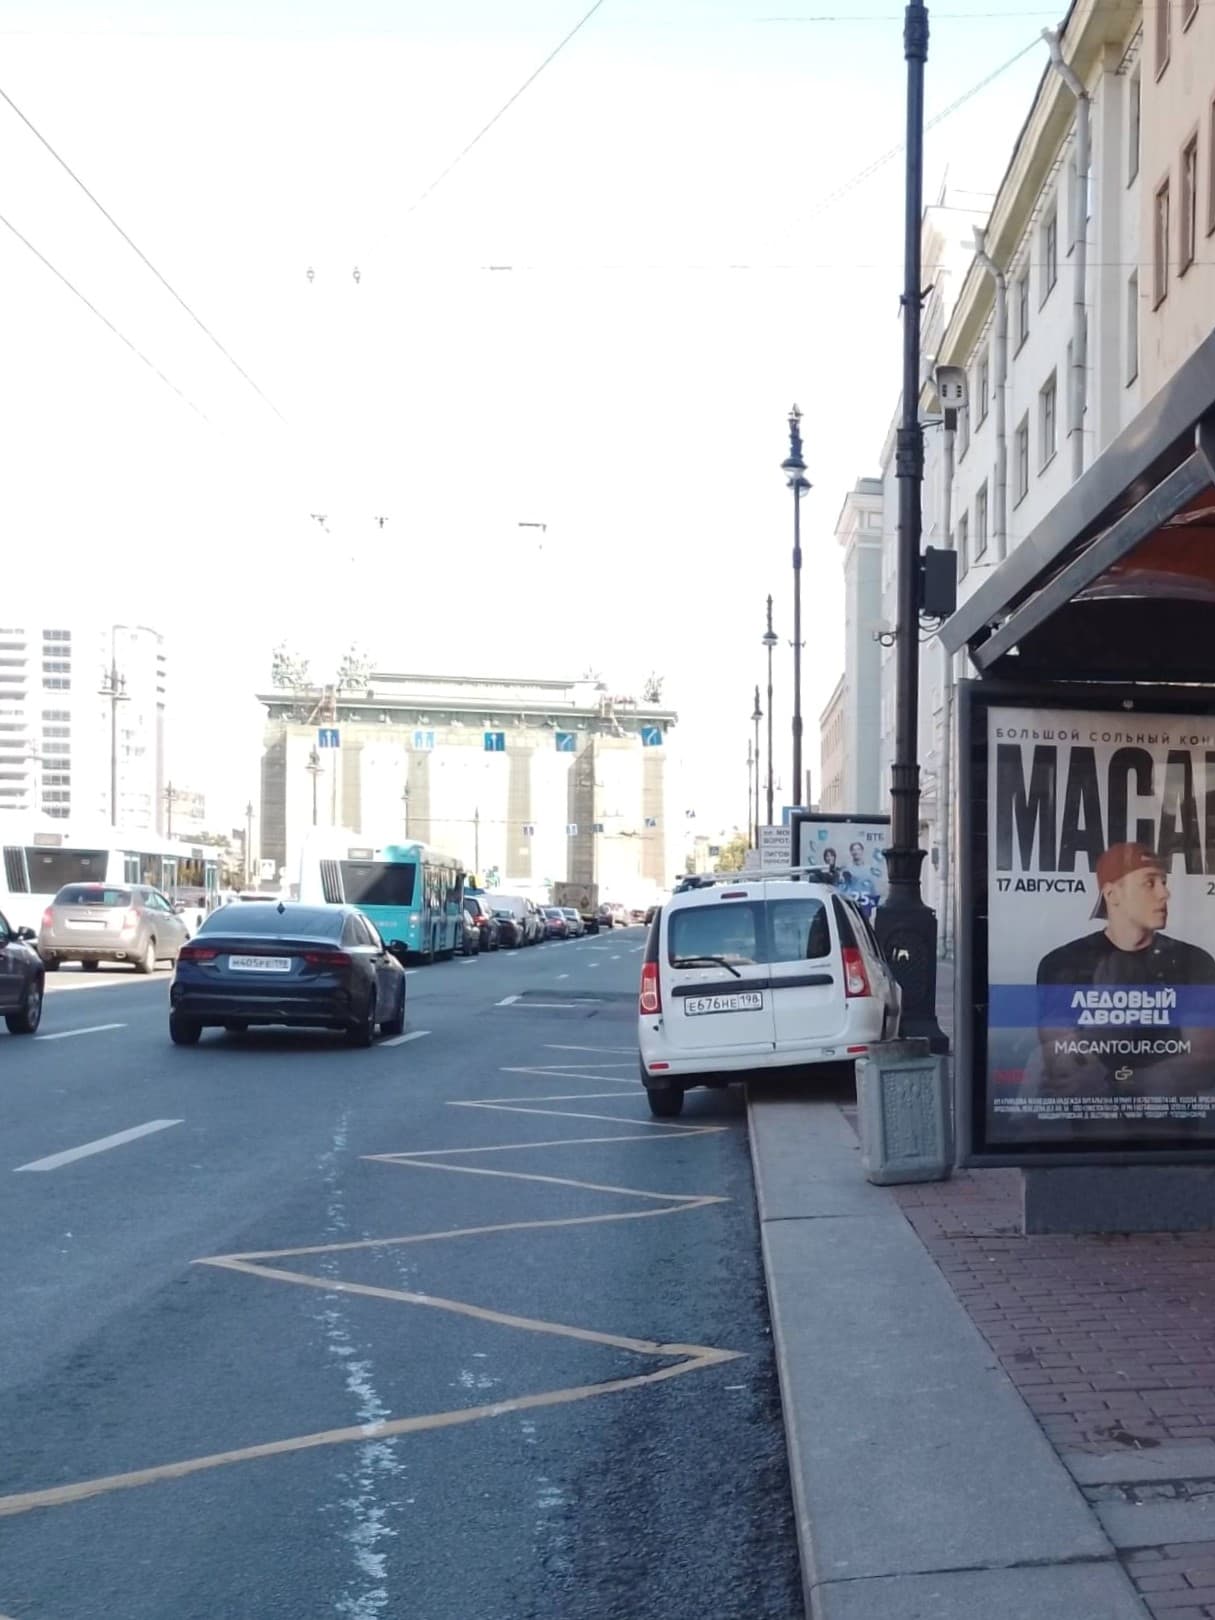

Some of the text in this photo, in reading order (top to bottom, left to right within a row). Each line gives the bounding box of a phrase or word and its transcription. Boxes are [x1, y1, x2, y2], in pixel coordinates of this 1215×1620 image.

[996, 727, 1080, 742] БОЛЬШОЙ
[1089, 731, 1171, 745] СОЛЬНЫЙ
[997, 878, 1012, 891] 17
[1014, 879, 1086, 893] АВГУСТА
[689, 998, 737, 1012] Е676НЕ
[1070, 988, 1177, 1009] ЛЕДОВЫЙ
[1077, 1010, 1170, 1026] ДВОРЕЦ
[1054, 1040, 1192, 1055] MACANTOUR.COM
